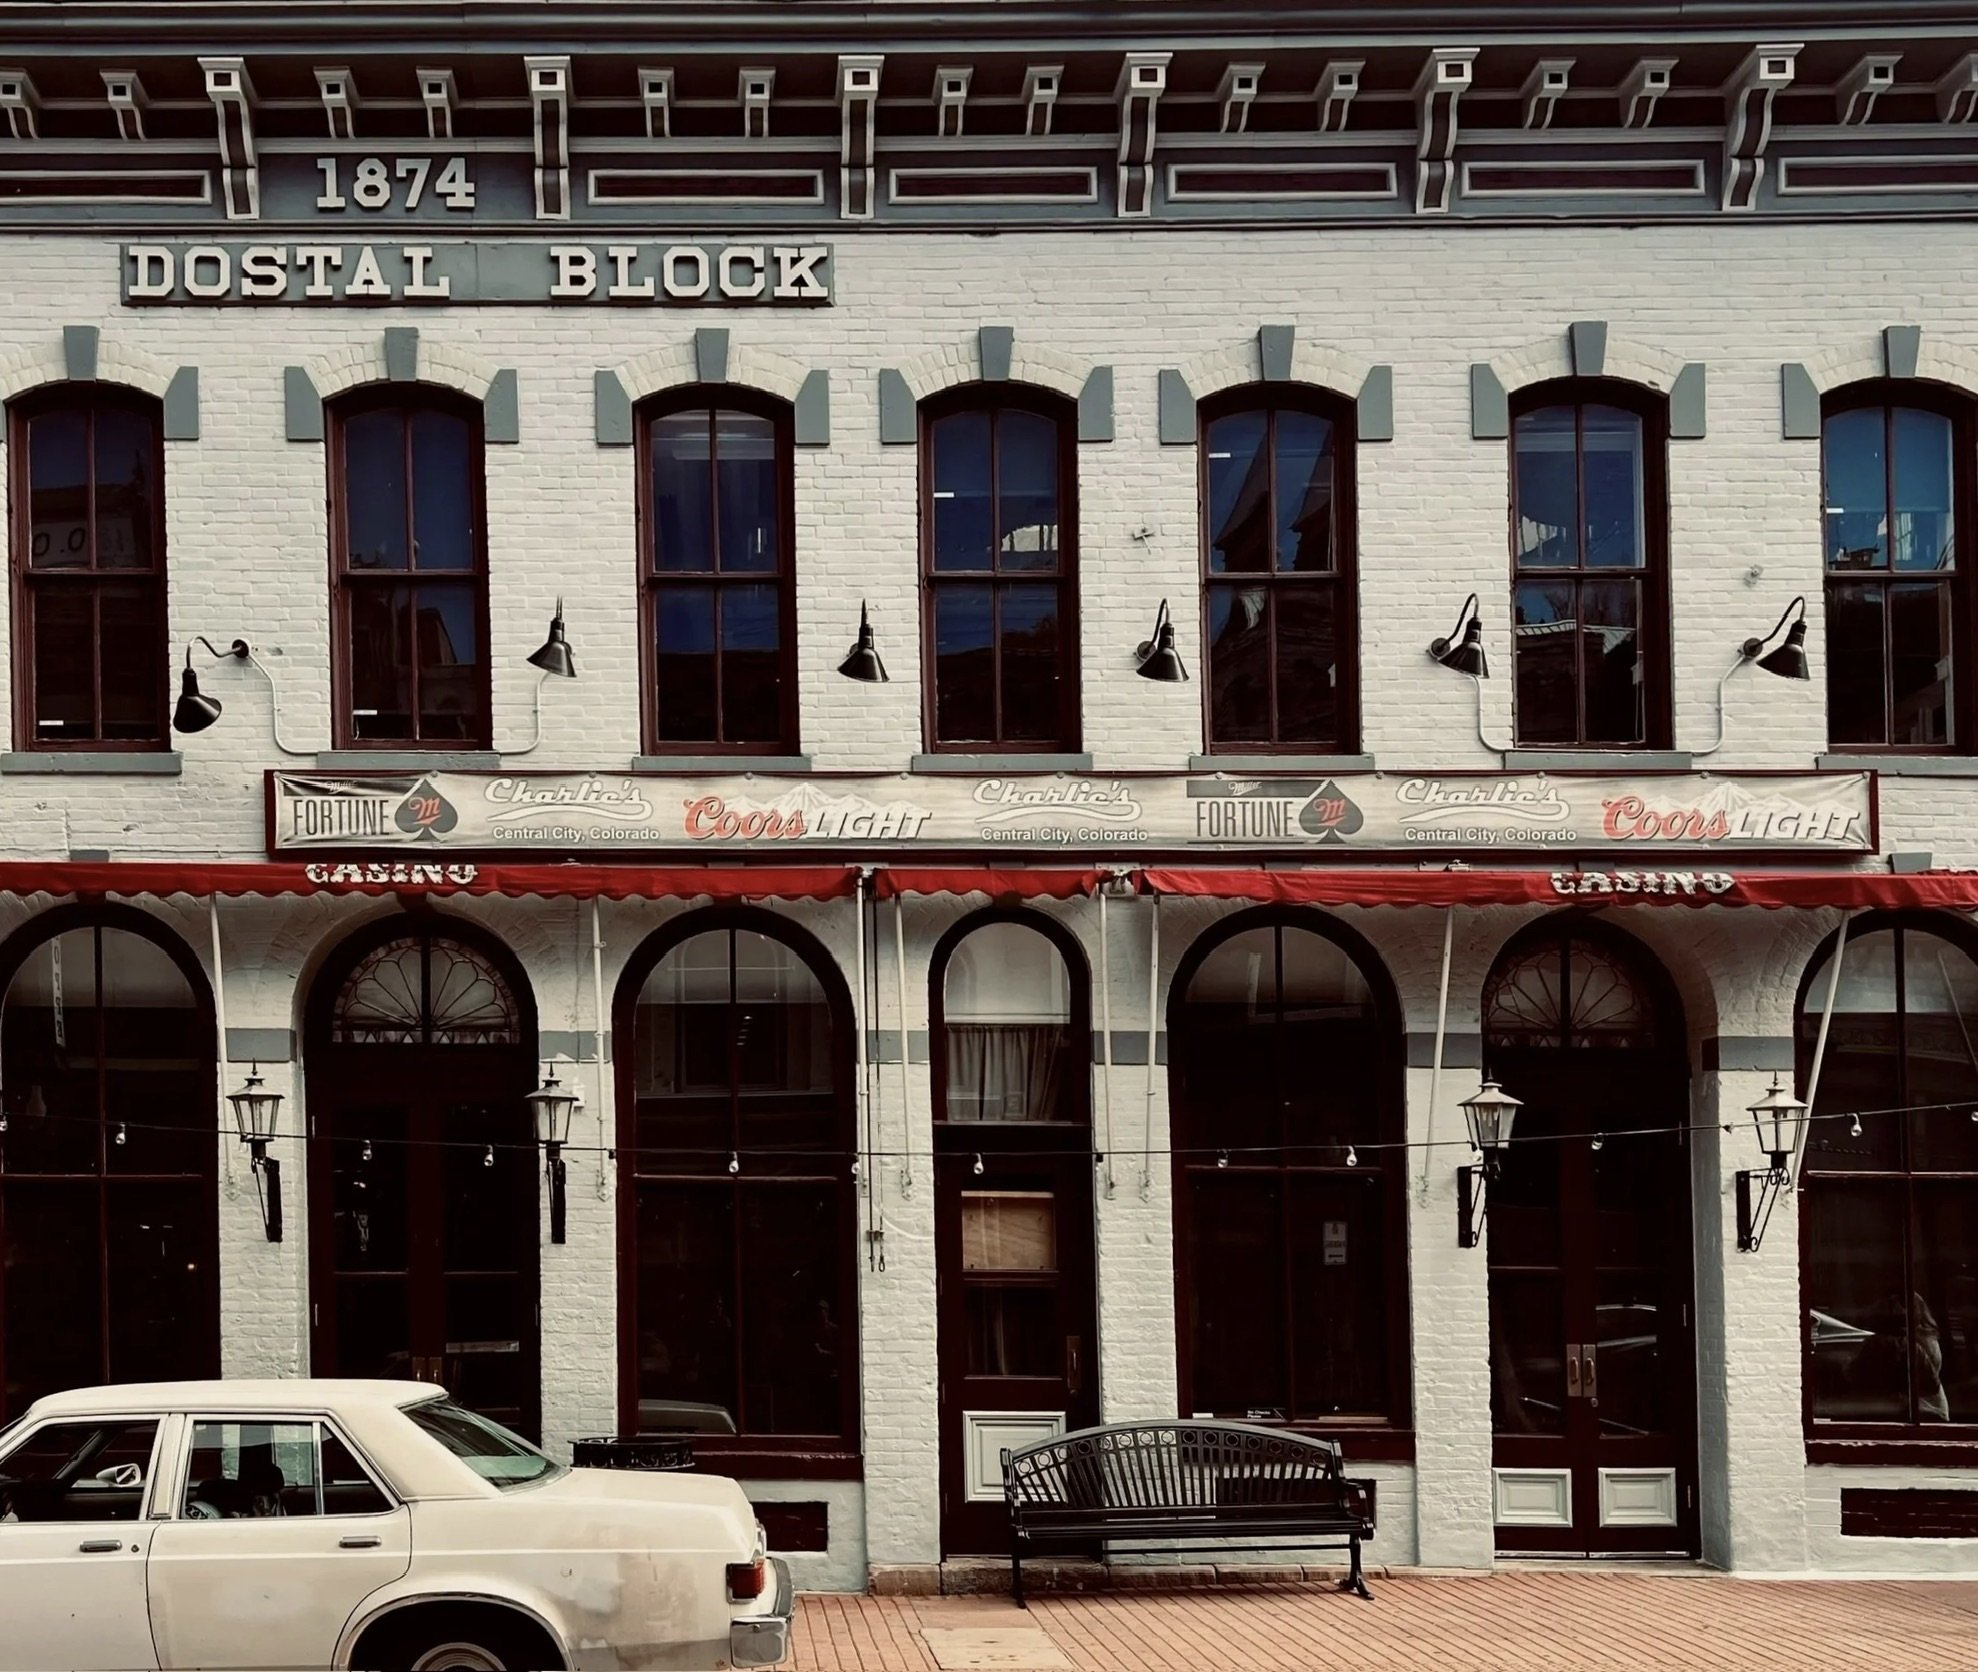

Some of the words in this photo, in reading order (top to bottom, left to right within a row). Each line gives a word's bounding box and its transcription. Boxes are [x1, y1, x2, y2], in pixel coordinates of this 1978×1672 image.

[316, 157, 475, 208] 1874
[128, 246, 450, 297] DOSTAL
[550, 246, 829, 297] BLOCK
[293, 799, 390, 836] FORTUNE
[484, 776, 653, 821] Charlie's
[683, 795, 808, 840] Coors
[806, 811, 933, 840] LIGHT
[972, 778, 1142, 823] Charlie's
[1196, 801, 1294, 837] FORTUNE
[1396, 777, 1570, 823] Charlie's
[1601, 795, 1730, 840] Coors
[1728, 811, 1861, 840] LIGHT
[492, 826, 548, 840] Central
[552, 826, 586, 843] City,
[590, 826, 660, 840] Colorado
[981, 827, 1036, 841] Central
[1040, 827, 1074, 844] City,
[1078, 827, 1149, 841] Colorado
[1405, 827, 1461, 841] Central
[1465, 827, 1500, 845] City,
[1504, 827, 1577, 841] Colorado
